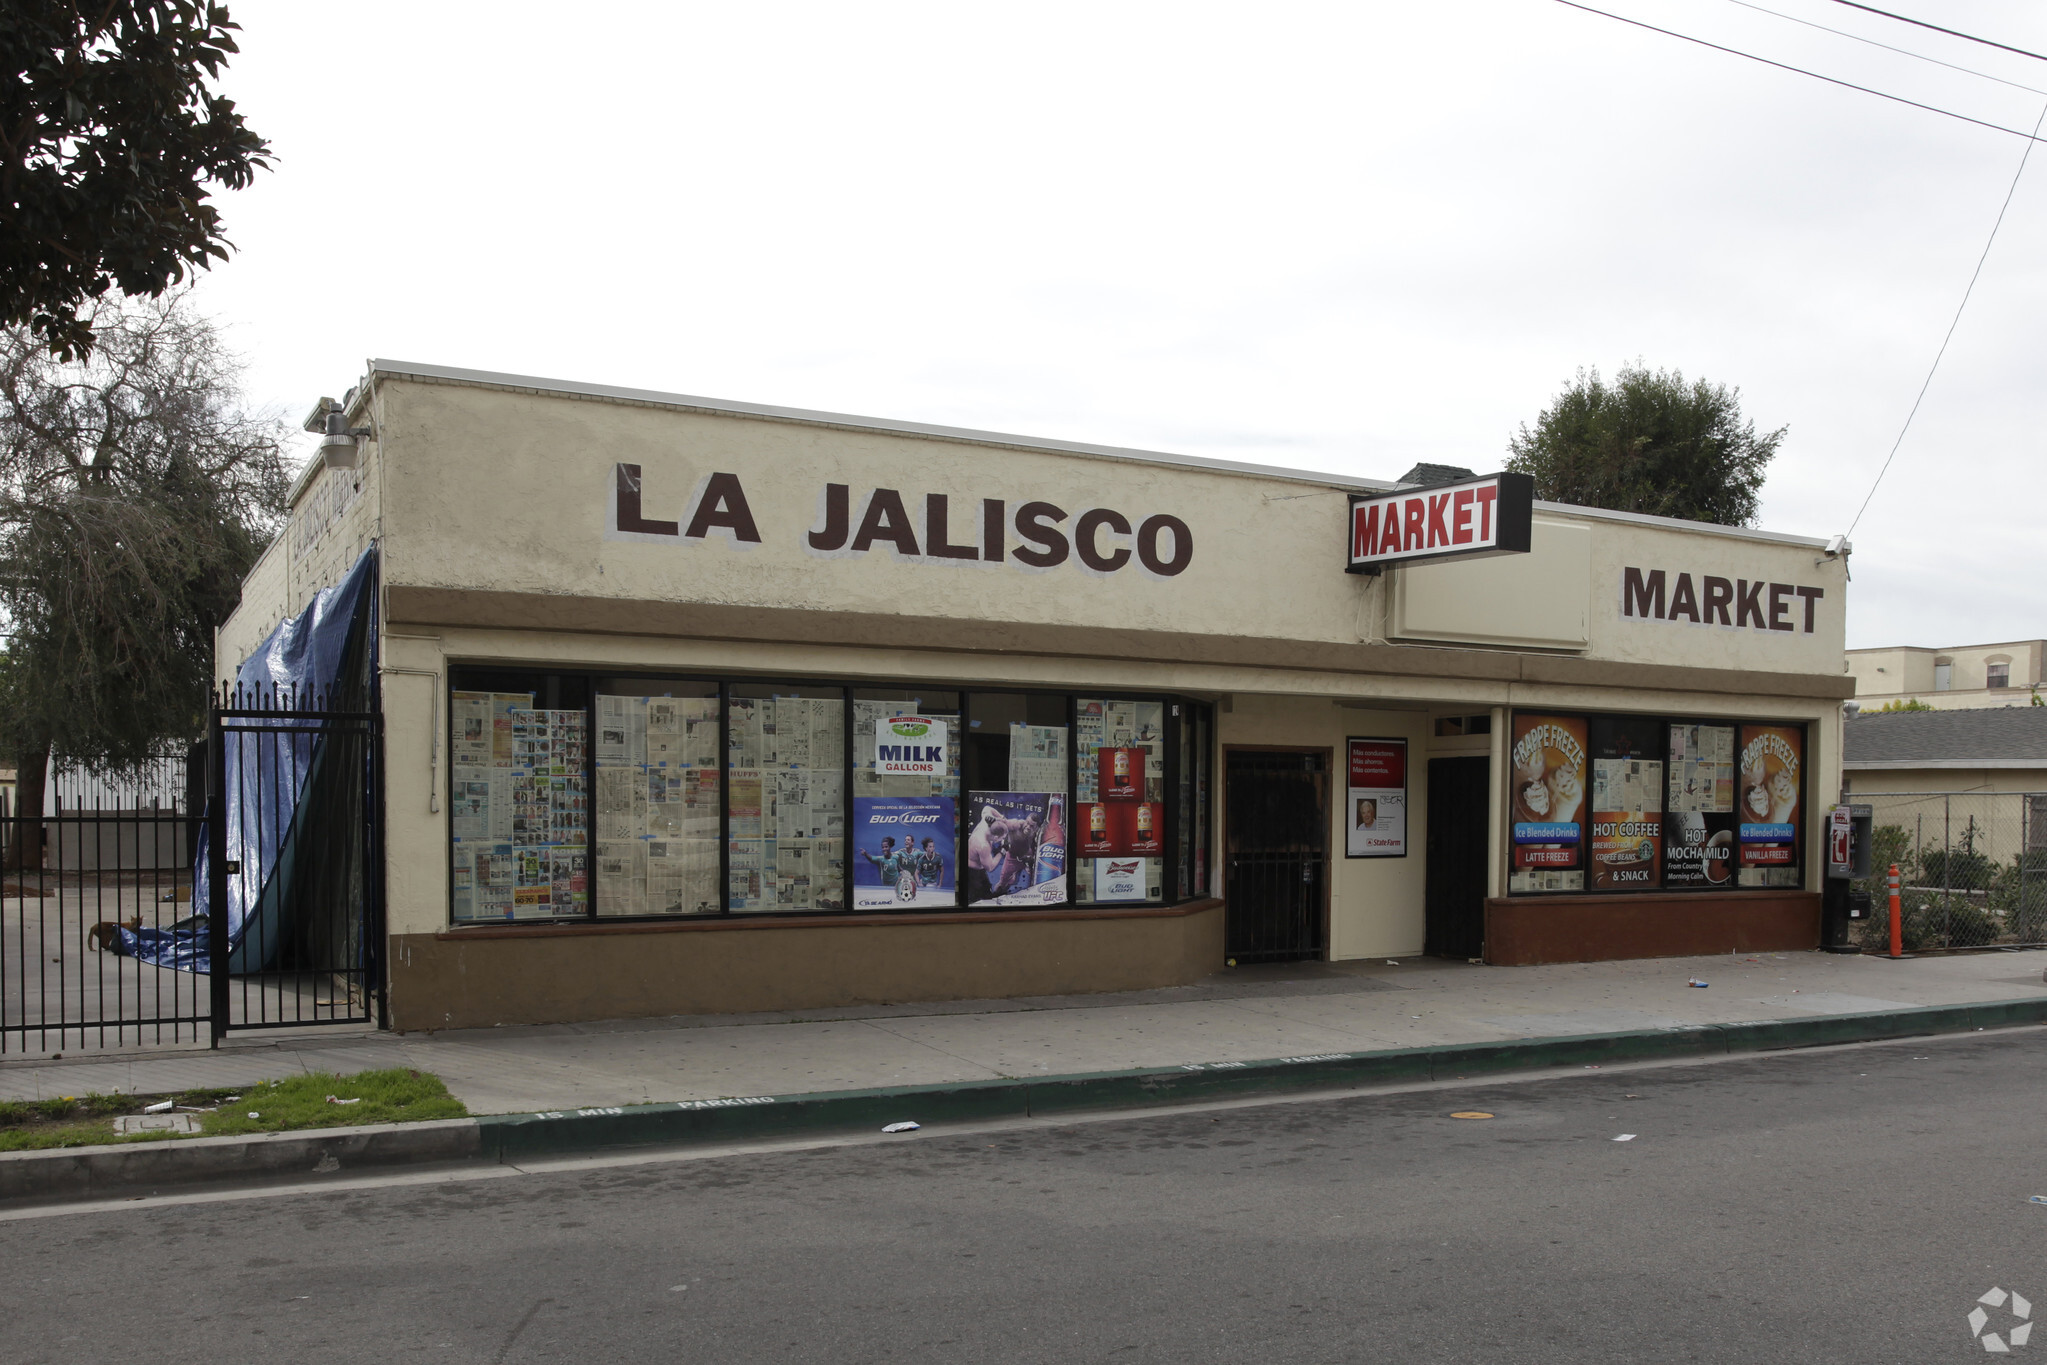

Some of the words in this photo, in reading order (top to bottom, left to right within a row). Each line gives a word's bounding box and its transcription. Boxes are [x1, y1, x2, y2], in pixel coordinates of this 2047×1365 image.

[616, 462, 762, 544] LA
[807, 481, 1195, 578] JALISCO
[1353, 484, 1498, 558] MARKET
[1623, 565, 1825, 634] MARKET
[879, 745, 943, 762] MILK
[1513, 724, 1549, 770] FRAPPE
[1550, 724, 1585, 772] FREEZE
[1740, 733, 1769, 775] FRAPPE
[1770, 734, 1799, 776] FREEZE
[886, 763, 934, 771] GALLONS
[985, 797, 1003, 807] REAL
[1005, 801, 1015, 809] AS
[1025, 804, 1042, 813] GETS
[869, 815, 898, 824] BUD
[902, 815, 941, 823] LIGHT
[1515, 827, 1526, 838] Ice
[1528, 827, 1555, 838] Blended
[1556, 827, 1578, 837] Drinks
[1593, 822, 1617, 837] HOT
[1619, 822, 1659, 837] COFFEE
[1740, 828, 1749, 837] Ice
[1750, 827, 1774, 837] Blended
[1774, 828, 1792, 837] Drinks
[1685, 829, 1708, 843] HOT
[1038, 851, 1065, 860] LIGHT
[1042, 846, 1065, 854] BUD
[1667, 847, 1704, 860] MOCHA
[1705, 847, 1730, 860] MILD
[1745, 850, 1769, 860] VANILLA
[1769, 850, 1789, 859] FREEZE
[1525, 852, 1545, 862] LATTE
[1546, 852, 1569, 862] FREEZE
[1595, 853, 1617, 861] COFFEE
[1617, 853, 1636, 861] BEANS
[1667, 862, 1682, 870] From
[1682, 862, 1703, 871] Country
[1612, 871, 1620, 881] &
[1620, 870, 1649, 881] SNACK
[1667, 872, 1690, 881] Morning
[1690, 872, 1704, 880] Calm
[1043, 891, 1064, 902] UFC
[534, 1111, 566, 1121] 15
[576, 1107, 625, 1118] MIN
[676, 1096, 776, 1110] PARKING
